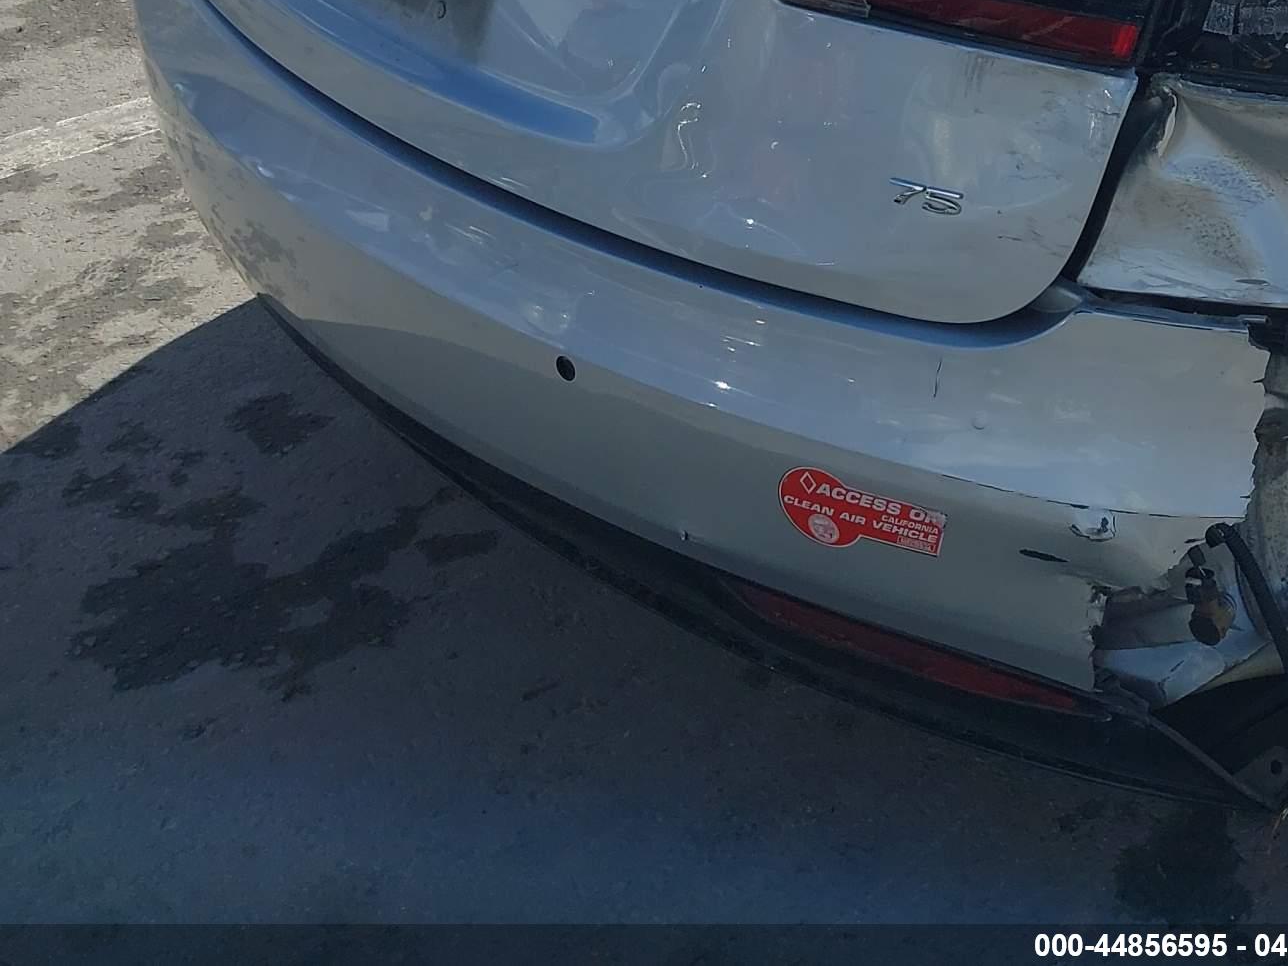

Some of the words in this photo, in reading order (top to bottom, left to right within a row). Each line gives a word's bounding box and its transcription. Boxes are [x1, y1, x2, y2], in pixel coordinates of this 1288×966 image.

[889, 177, 963, 215] 75
[816, 483, 901, 515] ACCESS
[783, 495, 834, 516] CLEAN
[840, 512, 866, 525] AIR
[873, 520, 938, 543] VEHICLE
[881, 514, 939, 534] CALIFORNIA
